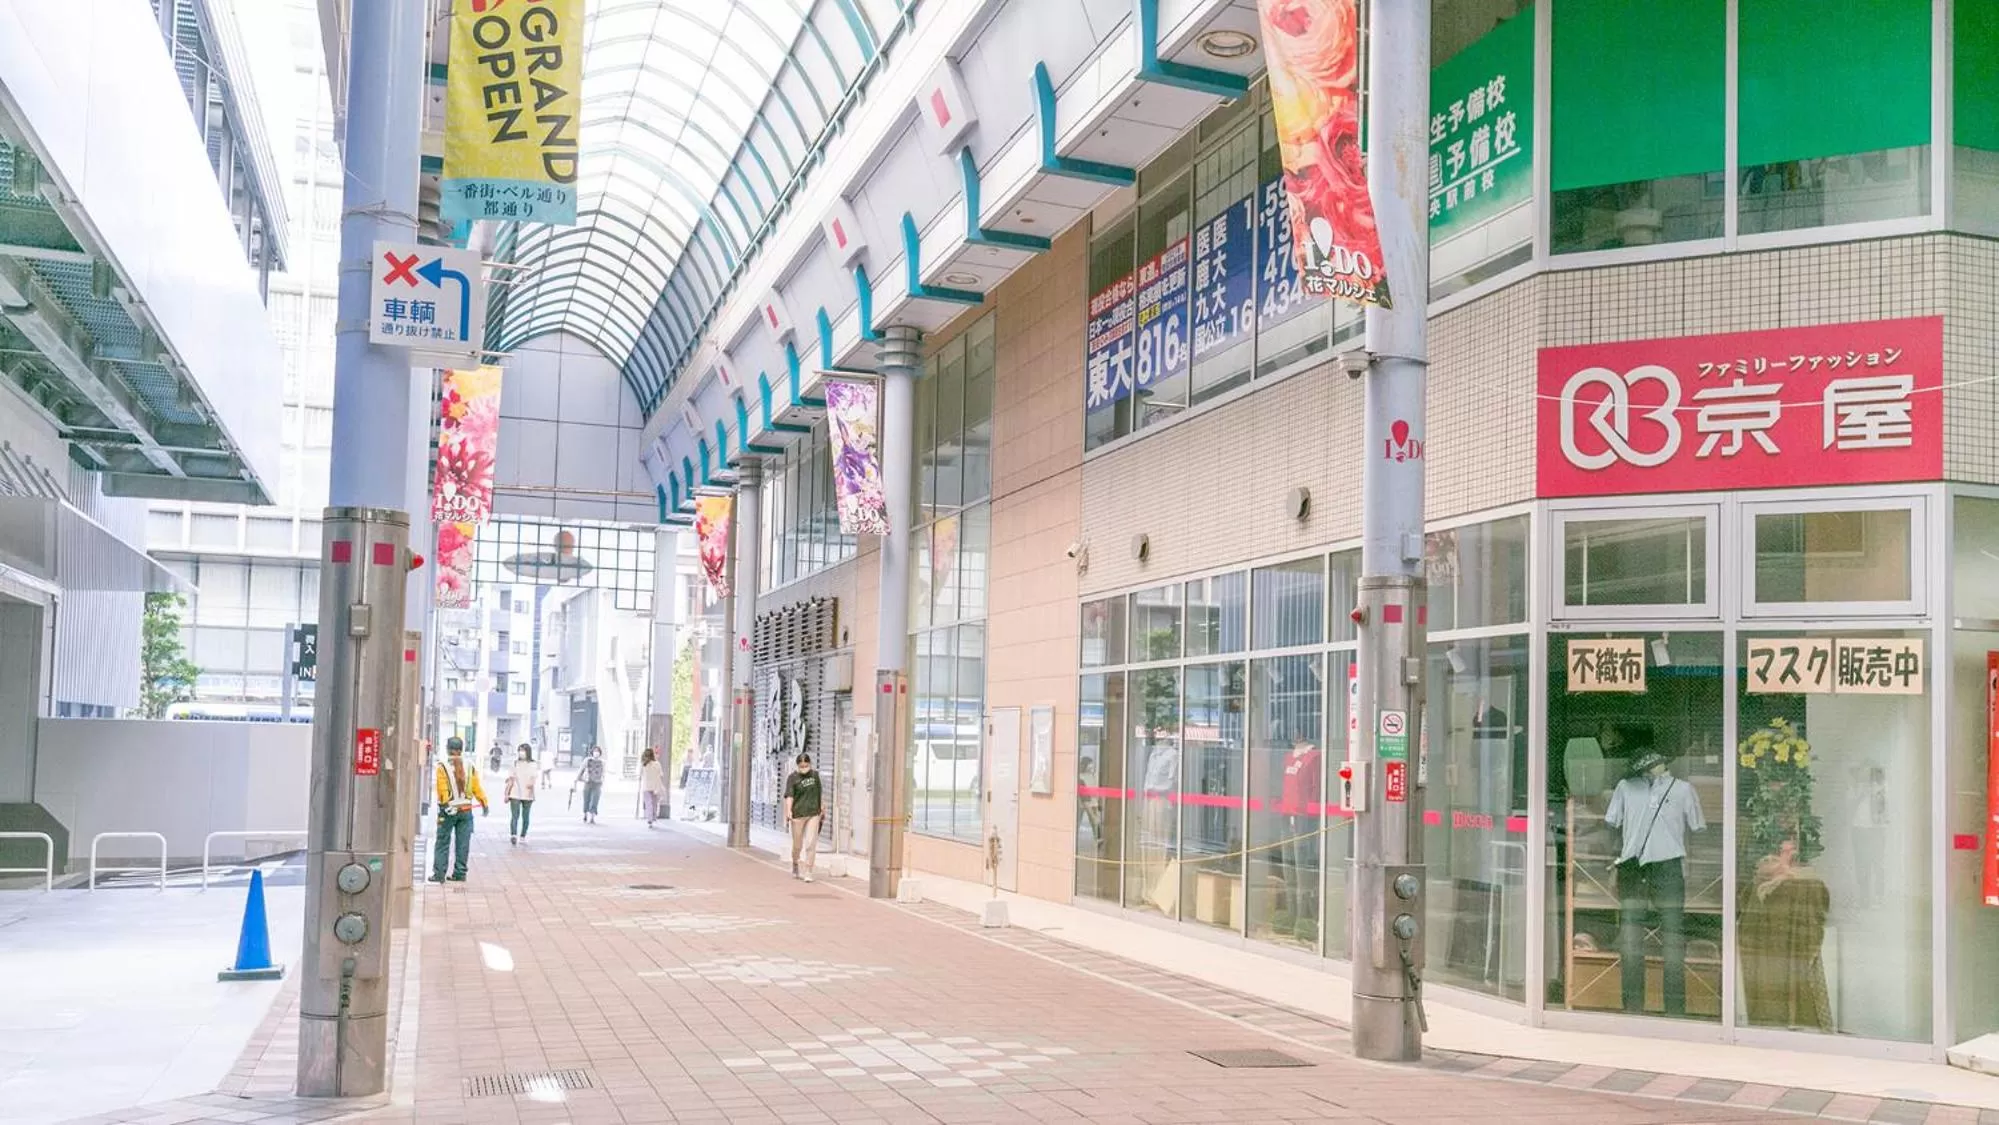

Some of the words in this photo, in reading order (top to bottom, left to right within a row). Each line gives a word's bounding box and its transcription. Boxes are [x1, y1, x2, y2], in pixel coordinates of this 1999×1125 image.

[473, 15, 528, 144] OPEN
[520, 7, 578, 184] GRAND
[484, 200, 533, 216] 都通り
[1305, 274, 1377, 302] 花マルシェ
[382, 322, 456, 341] 通り抜け禁止
[1698, 348, 1902, 378] ファミリーファッション
[1692, 374, 1914, 457] 京屋
[1572, 647, 1643, 685] 不織布
[1750, 647, 1829, 686] マスク
[1839, 646, 1919, 687] 販売中
